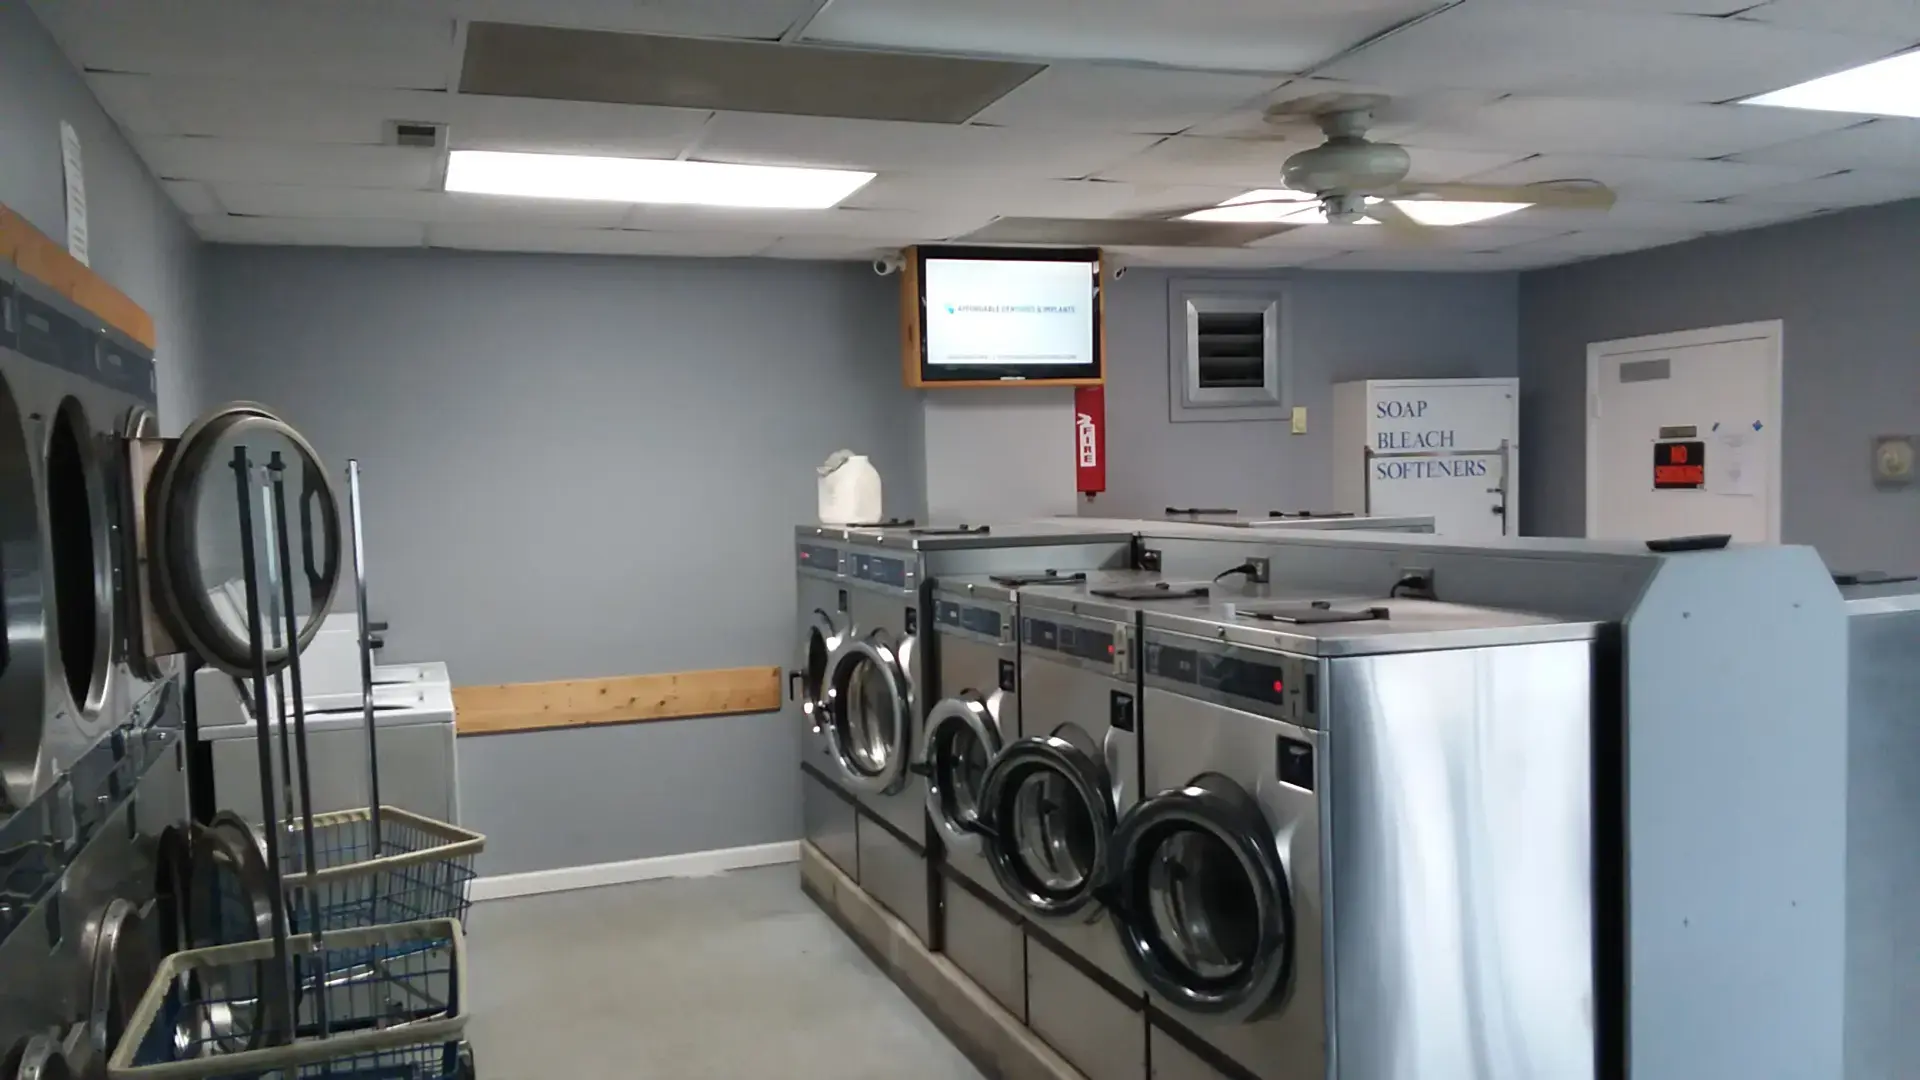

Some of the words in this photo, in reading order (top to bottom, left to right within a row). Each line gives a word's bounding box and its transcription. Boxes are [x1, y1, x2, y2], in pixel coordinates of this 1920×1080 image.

[1001, 305, 1035, 314] DENES
[1376, 400, 1428, 419] SOAP
[1082, 427, 1093, 463] FIRE
[1377, 430, 1455, 449] BLEACH
[1376, 460, 1487, 480] SOFTENERS
